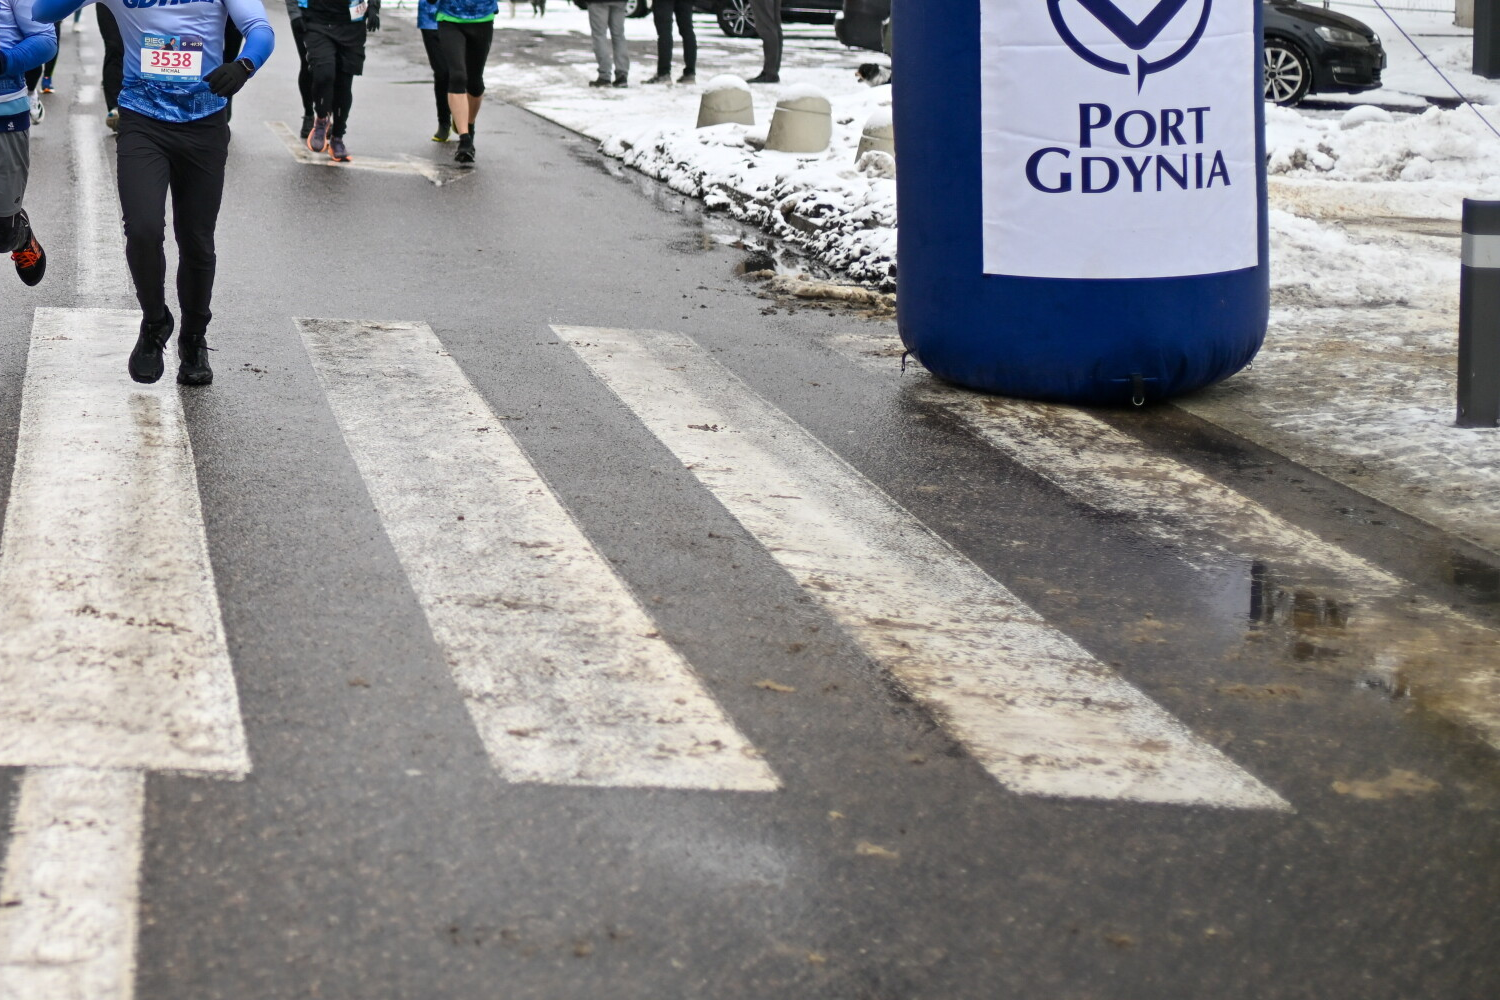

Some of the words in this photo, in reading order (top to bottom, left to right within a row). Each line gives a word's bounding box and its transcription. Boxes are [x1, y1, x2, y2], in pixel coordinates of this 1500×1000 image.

[150, 50, 192, 67] 3538
[1079, 103, 1211, 149] PORT
[1025, 147, 1232, 193] GDYNIA
